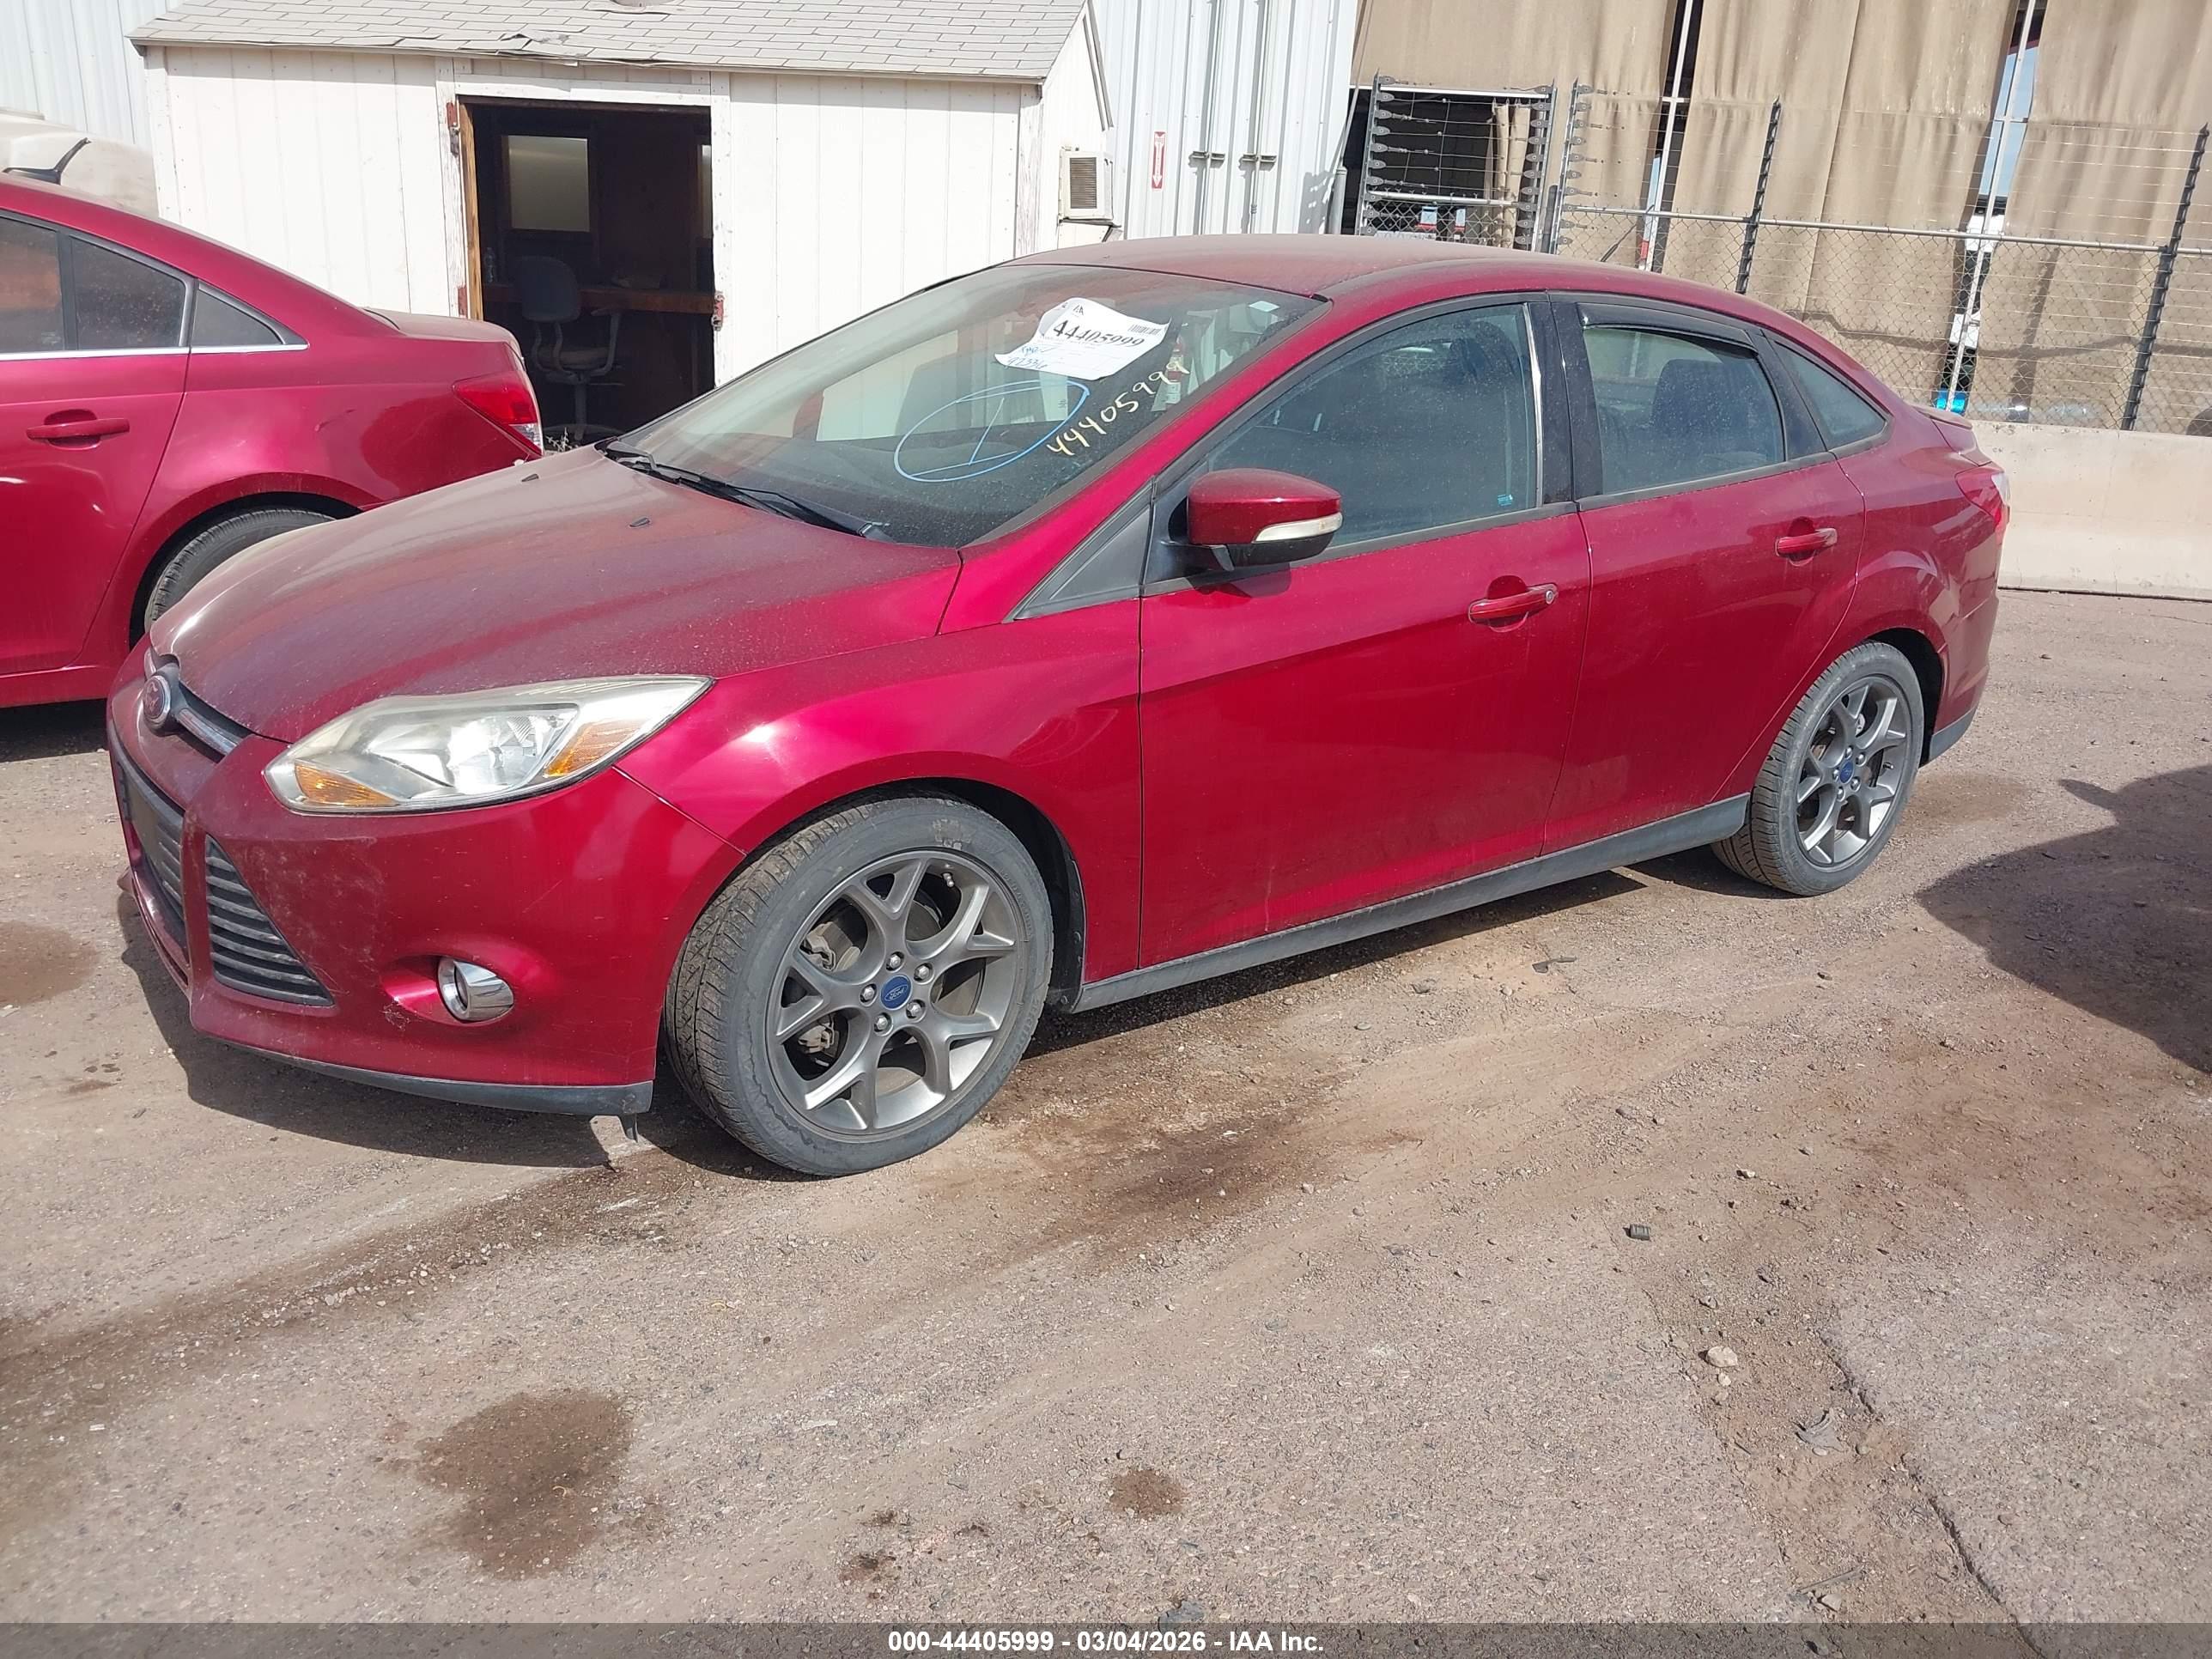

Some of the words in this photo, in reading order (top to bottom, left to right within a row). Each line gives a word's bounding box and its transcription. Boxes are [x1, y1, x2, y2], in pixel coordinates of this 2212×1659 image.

[1053, 319, 1146, 348] 44405999
[1045, 360, 1190, 456] 44405999
[887, 987, 907, 1000] Ford
